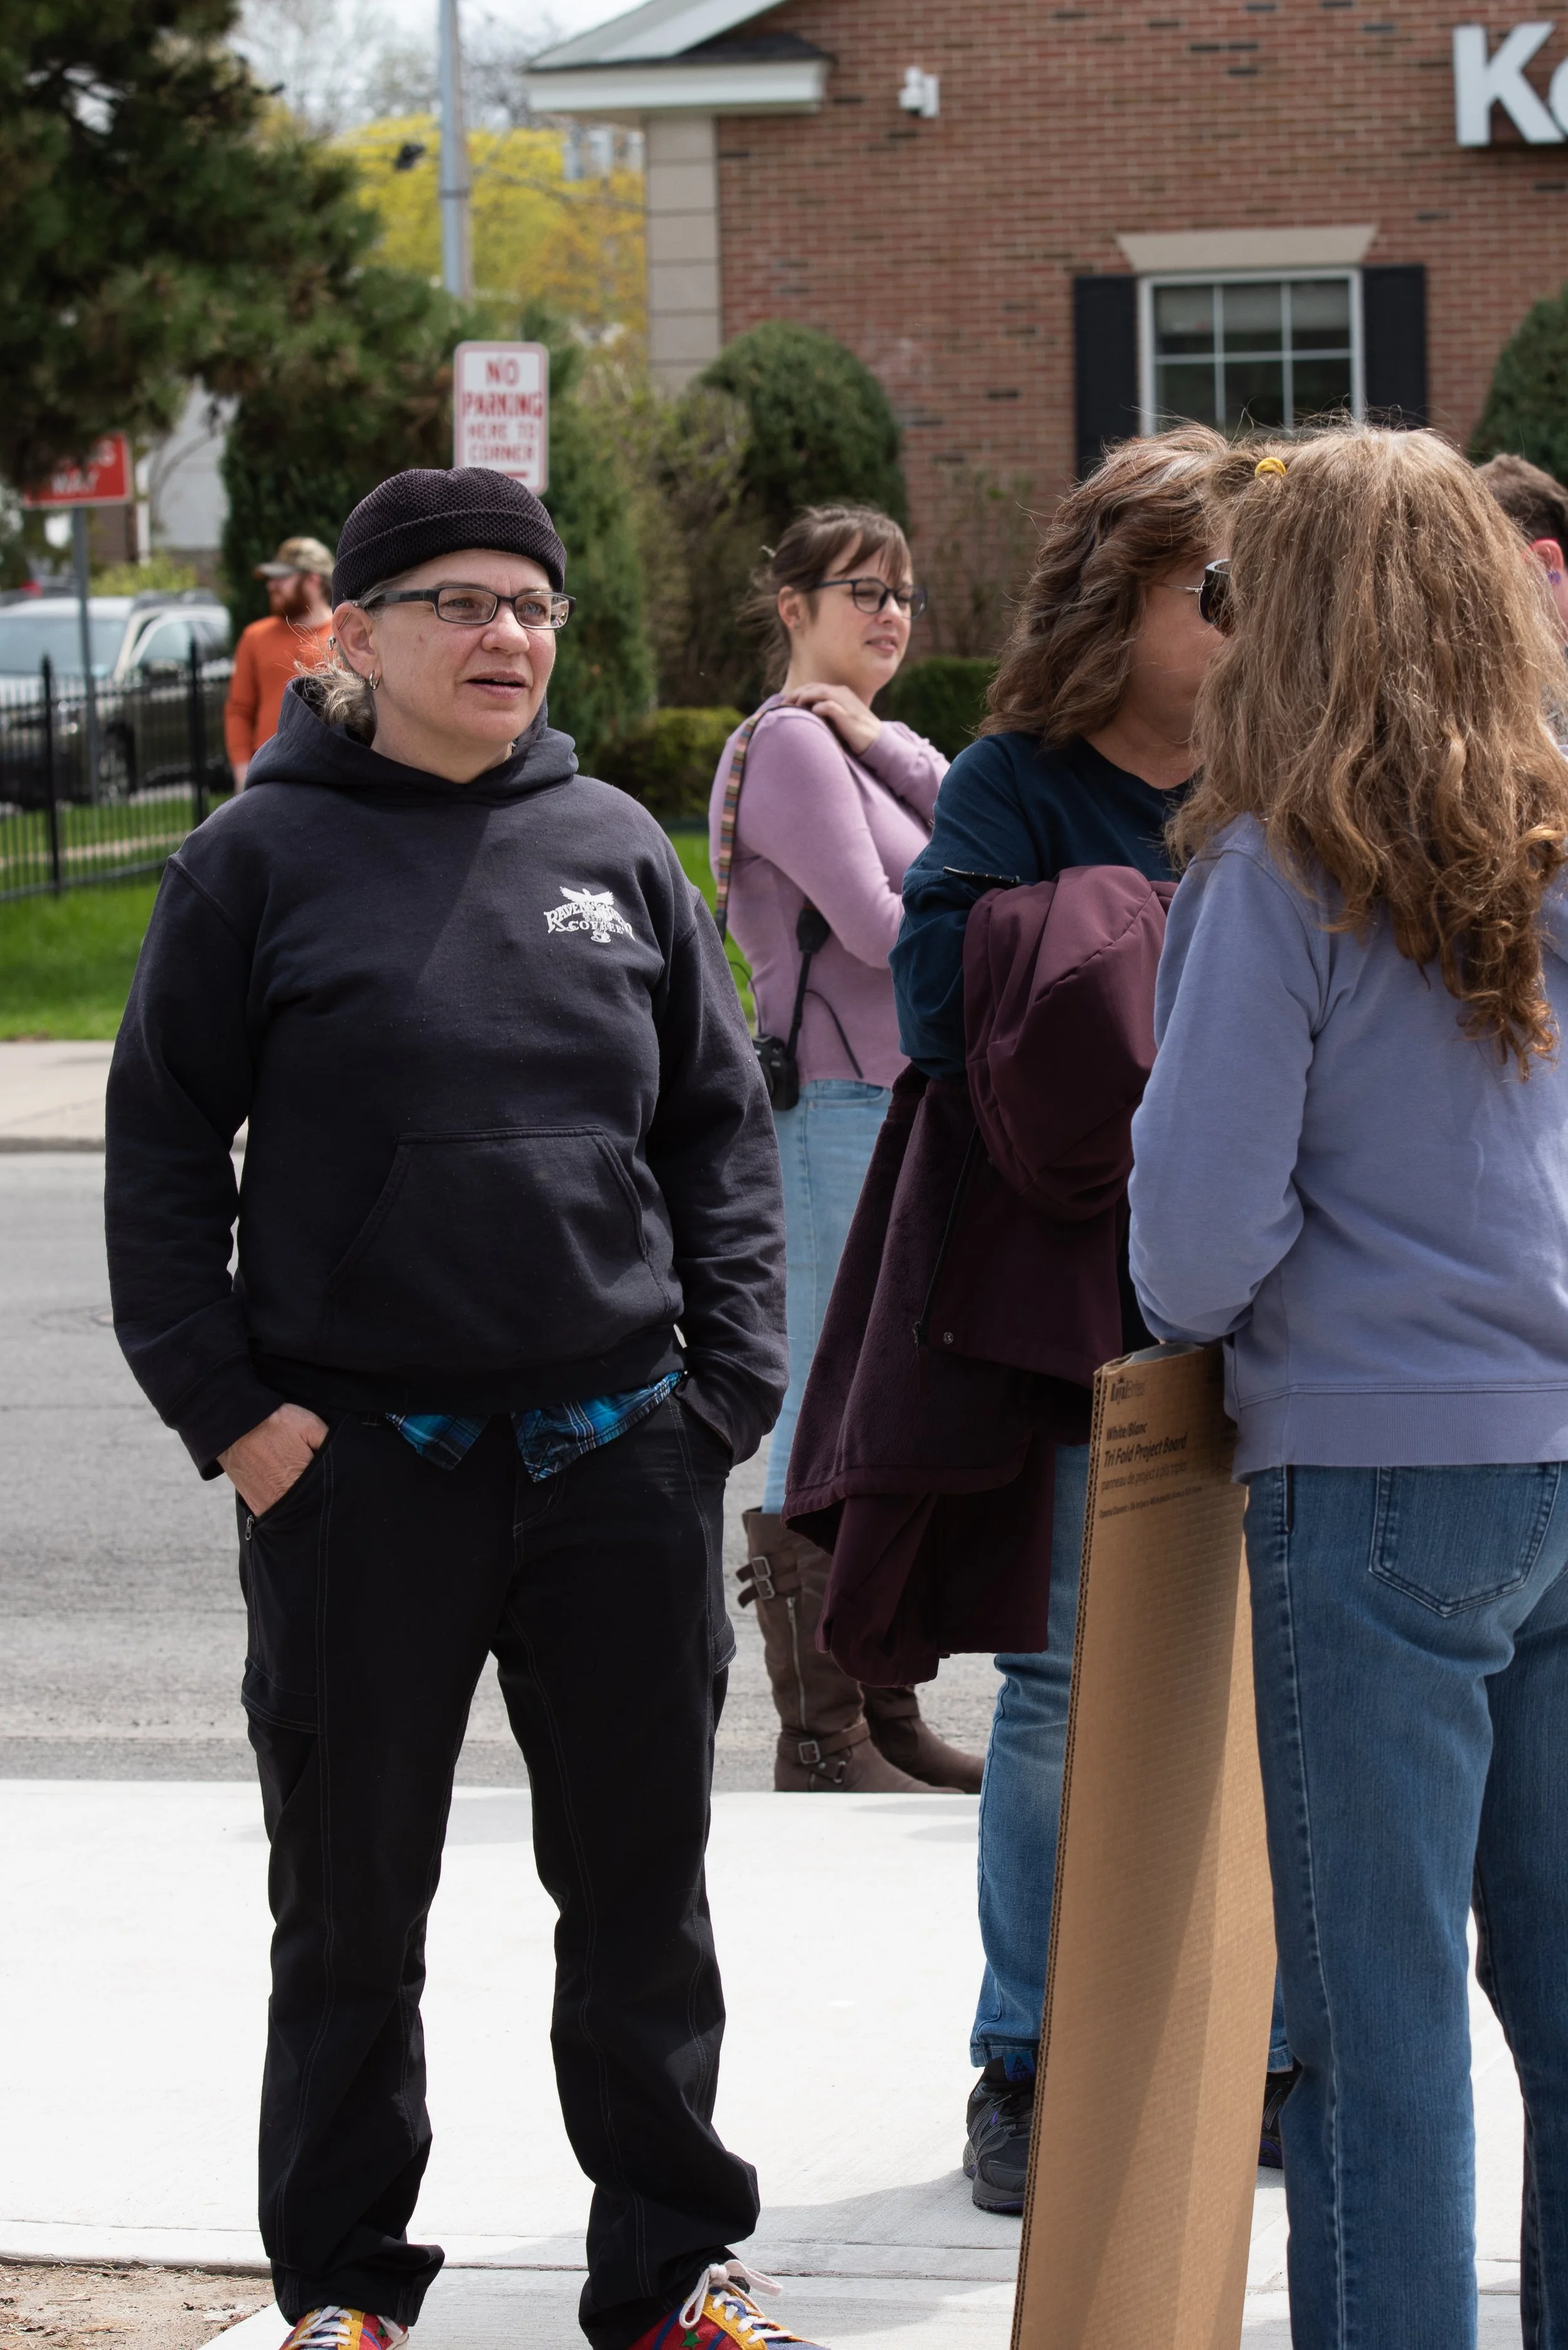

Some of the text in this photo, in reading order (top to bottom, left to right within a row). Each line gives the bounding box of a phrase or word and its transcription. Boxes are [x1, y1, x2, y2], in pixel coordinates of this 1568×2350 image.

[1452, 21, 1568, 146] K
[485, 358, 520, 386] NO
[462, 393, 543, 417] PARKING
[467, 423, 534, 439] HERE TO
[469, 444, 535, 461] CORNER
[1104, 1432, 1187, 1467] Tri Fold Project Board
